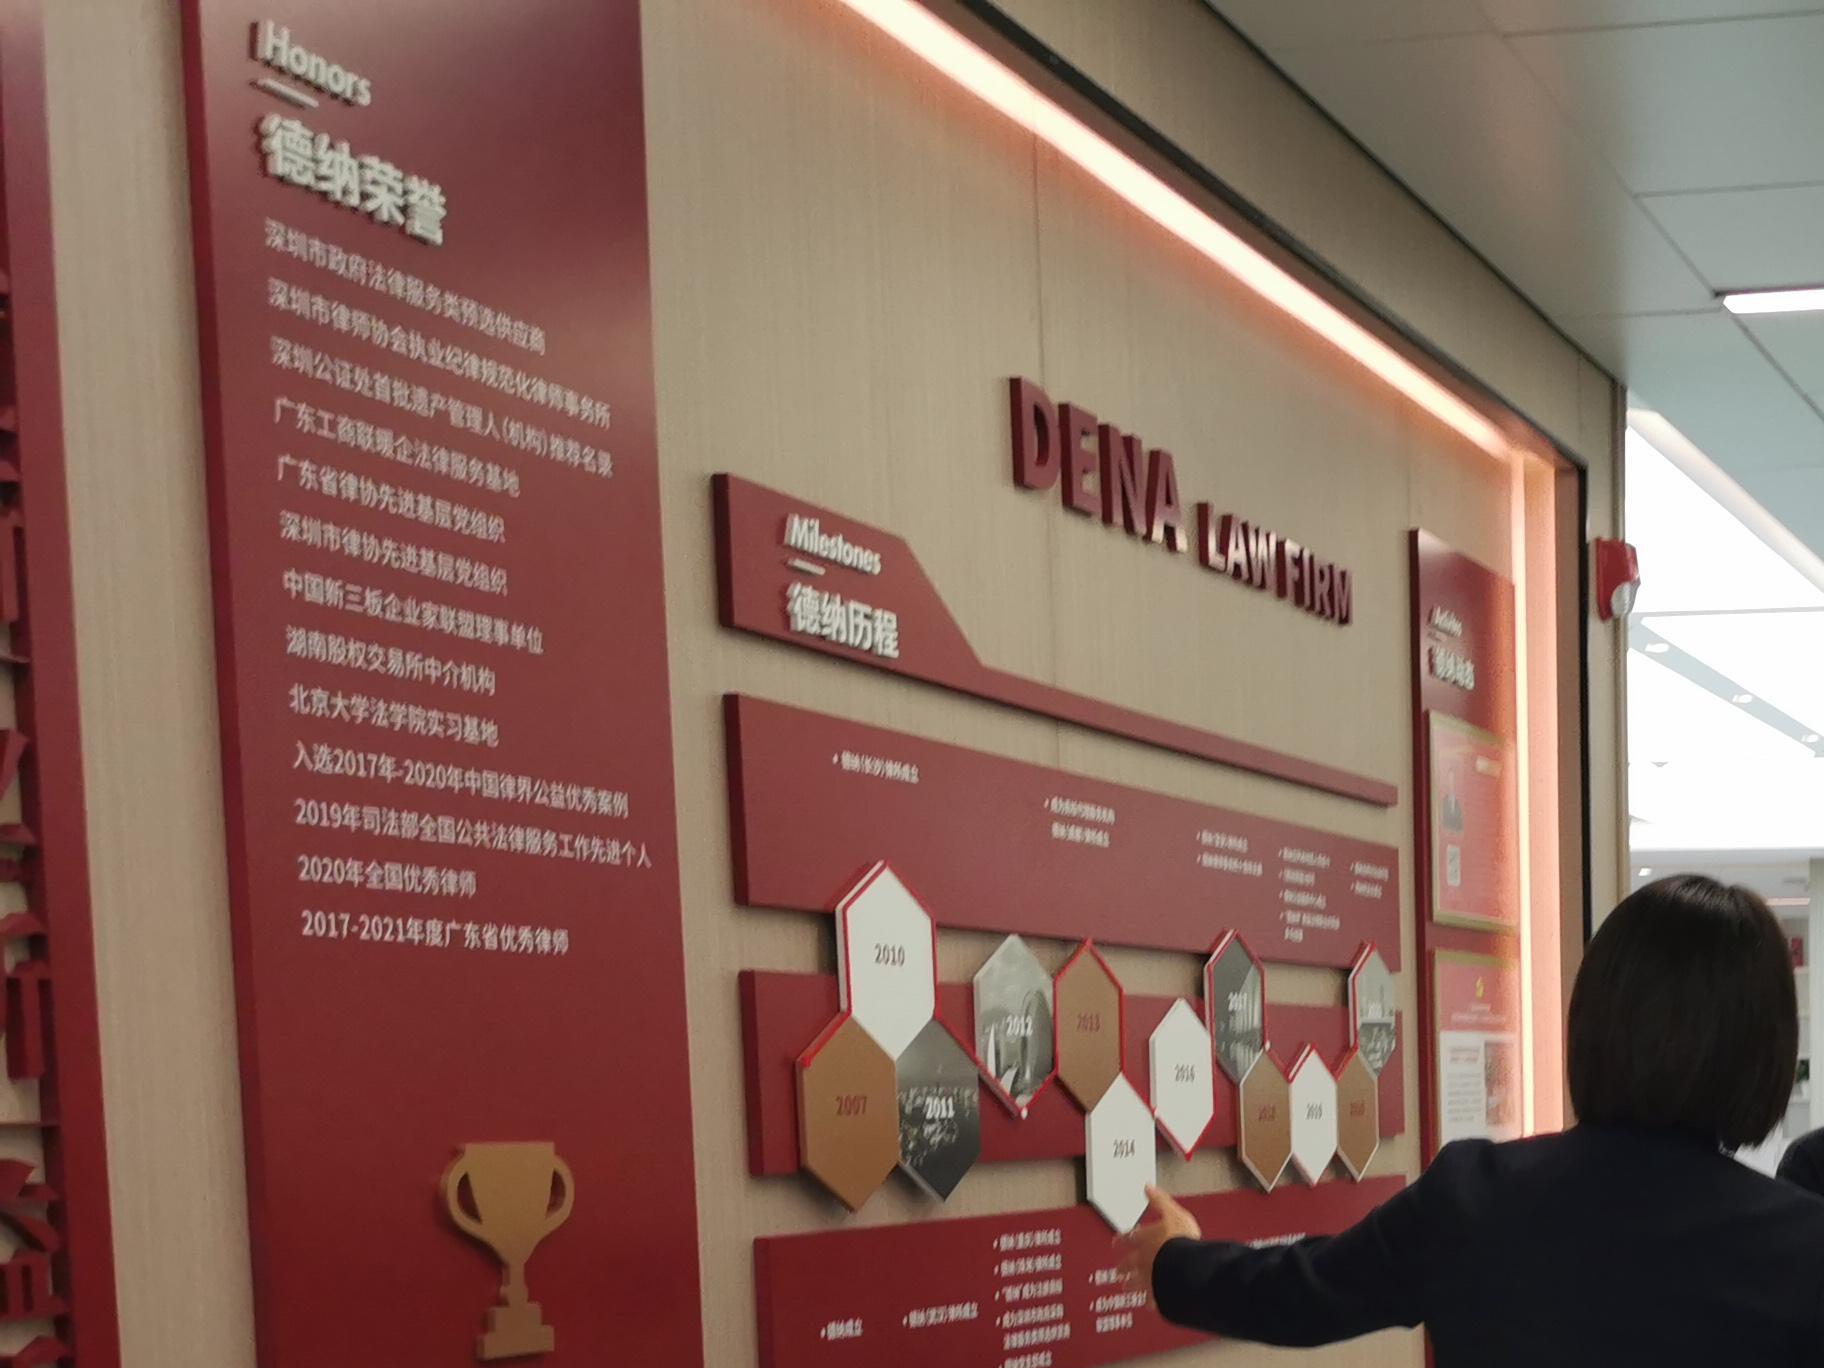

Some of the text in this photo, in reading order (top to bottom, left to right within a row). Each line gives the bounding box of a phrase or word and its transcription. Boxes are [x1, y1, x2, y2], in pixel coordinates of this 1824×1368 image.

[255, 19, 372, 107] Honors
[260, 113, 448, 247] 德纳荣誉
[277, 453, 506, 544] 广东省律协先进基层党组织
[1009, 376, 1353, 626] DENA LAW FIRM
[280, 510, 508, 597] 深圳市律协先进基层党组织
[785, 513, 882, 576] Milestones
[786, 581, 900, 659] 德纳历程
[286, 624, 496, 696] 湖南股权交易所中介机构
[289, 683, 499, 747] 北京大学法学院实习基地
[294, 798, 652, 870] 2019年司法部全国公共法律服务工作先进个人
[297, 855, 477, 899] 2020年全国优秀律师
[301, 909, 569, 956] 2017-2021年度广东省优秀律师
[873, 942, 906, 968] 2010
[1005, 1013, 1034, 1038] 2012
[836, 1094, 868, 1117] 2007
[925, 1095, 955, 1121] 2011
[1112, 1138, 1136, 1159] 2014
